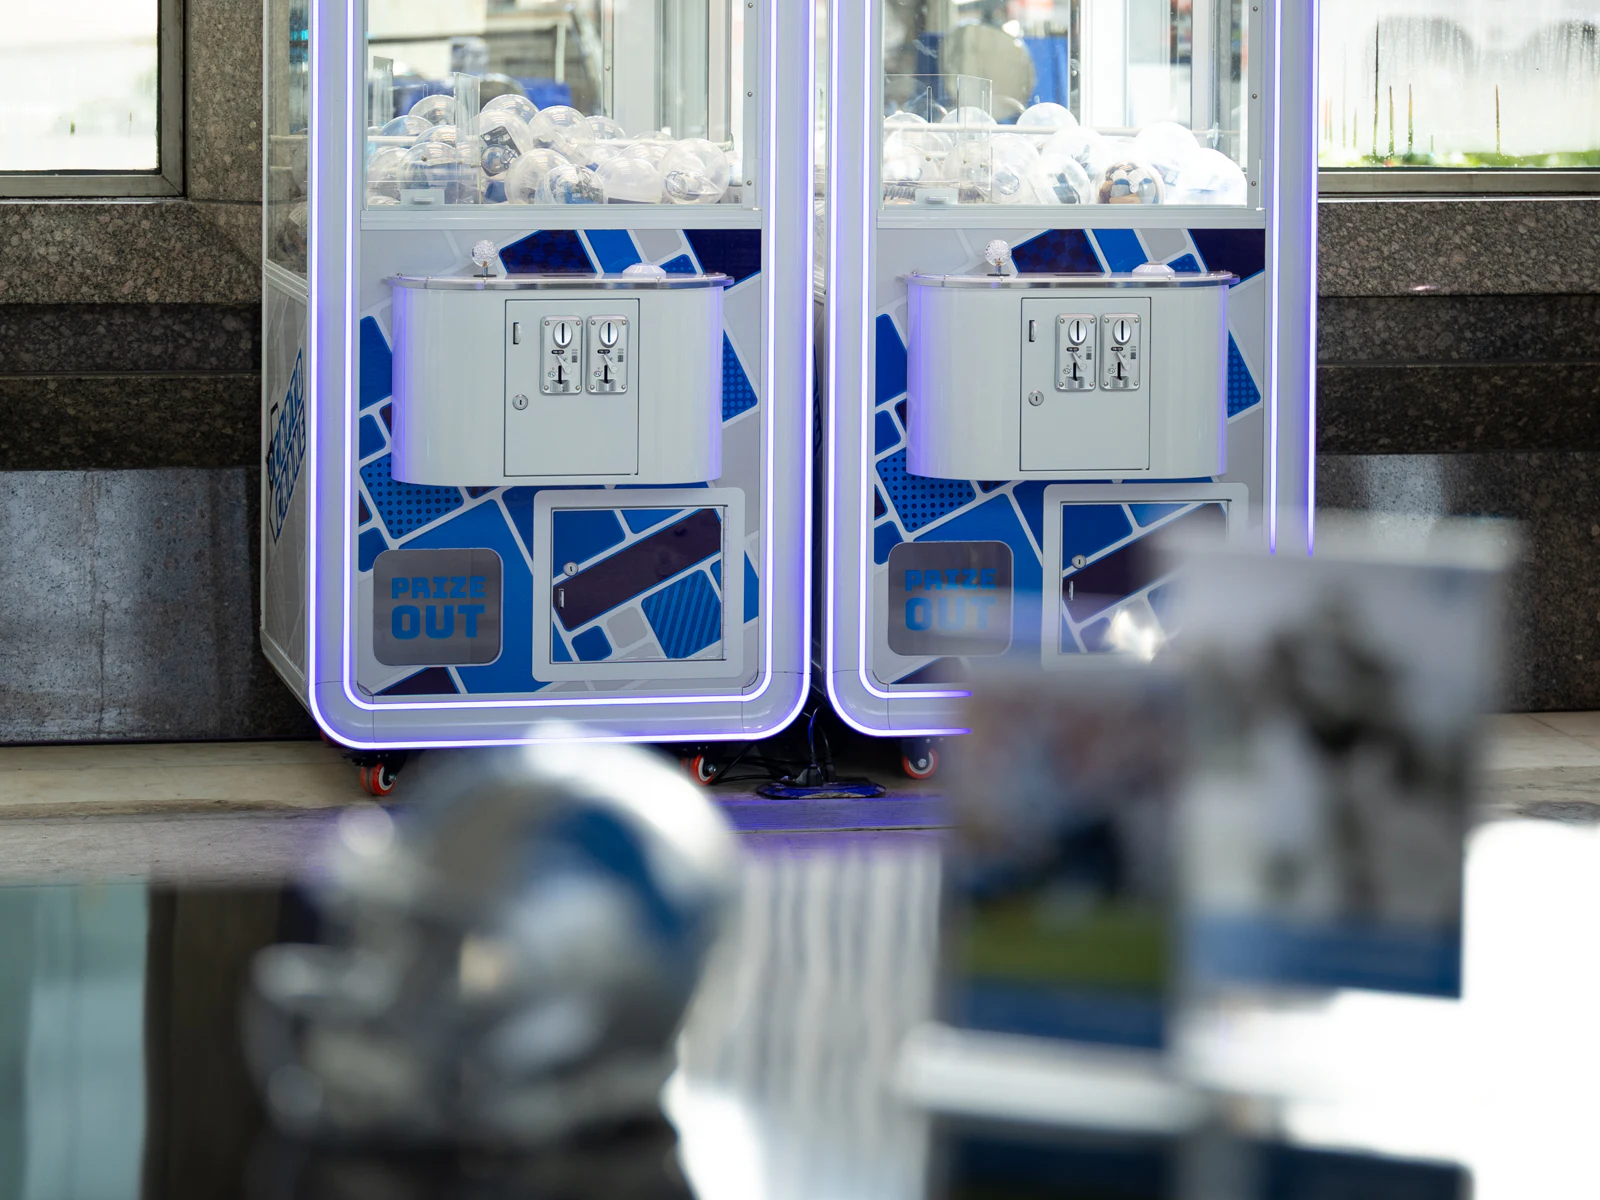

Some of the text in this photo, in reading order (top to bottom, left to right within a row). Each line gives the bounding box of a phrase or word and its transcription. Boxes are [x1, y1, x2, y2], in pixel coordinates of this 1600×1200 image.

[391, 576, 486, 599] PRIZE
[905, 568, 997, 591] PRIZE
[391, 604, 486, 640] OUT
[905, 596, 997, 631] OUT
